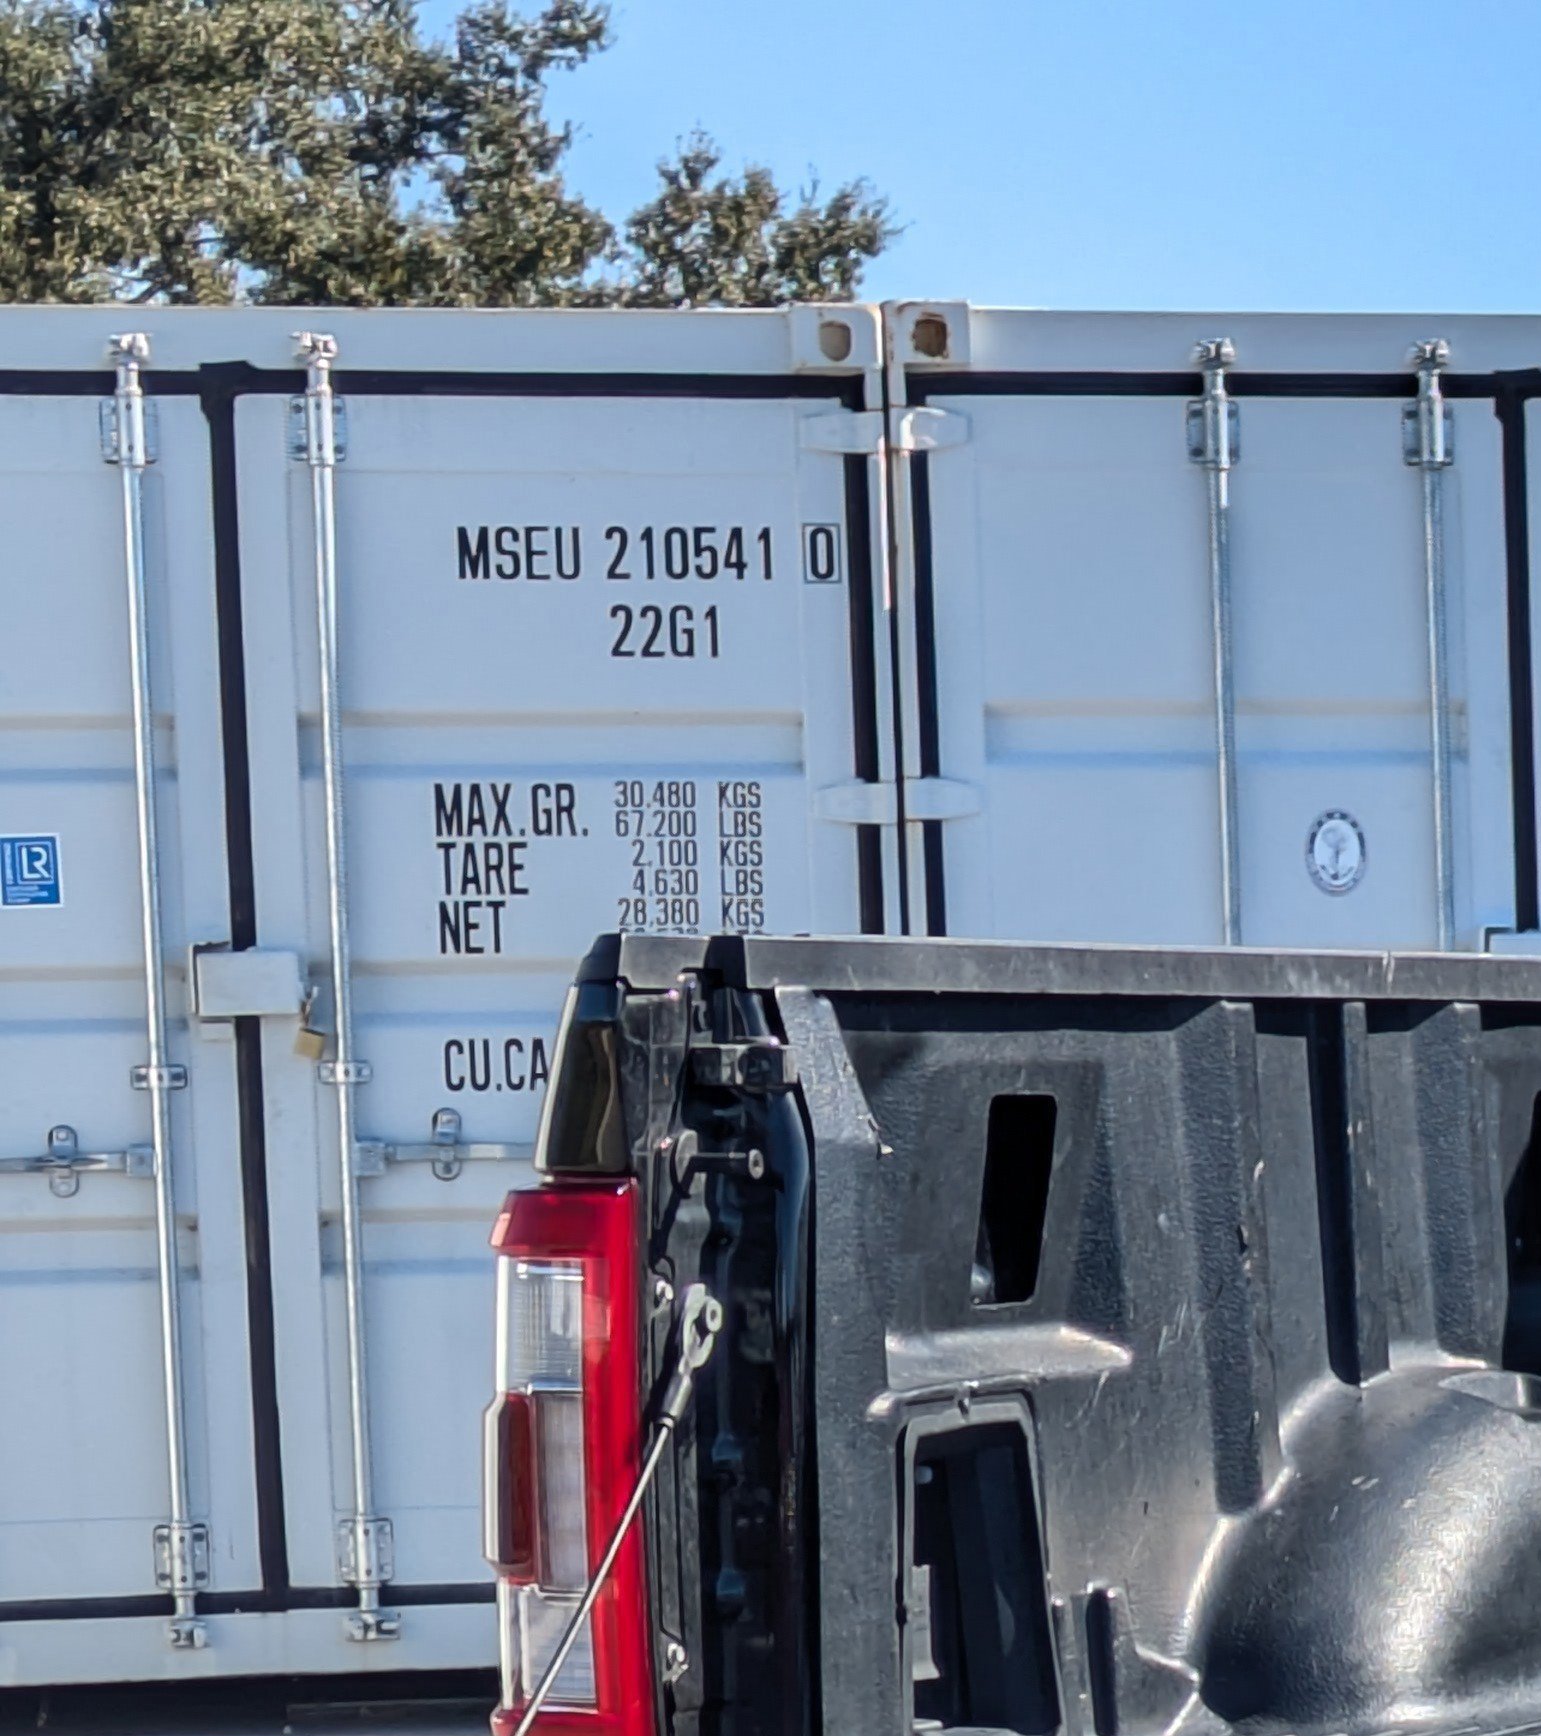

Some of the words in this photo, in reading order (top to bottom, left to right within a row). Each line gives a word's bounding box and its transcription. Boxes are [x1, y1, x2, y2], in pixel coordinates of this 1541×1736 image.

[456, 525, 582, 581] MSEU
[604, 525, 774, 581] 210541
[808, 525, 837, 580] 0
[609, 603, 720, 659] 22G1
[433, 782, 589, 838] MAX.GR.
[717, 781, 762, 809] KGS
[718, 810, 763, 838] LBS
[436, 841, 530, 896] TARE
[719, 840, 764, 867] KGS
[720, 869, 764, 896] LBS
[438, 900, 506, 955] NET
[721, 898, 765, 927] KGS
